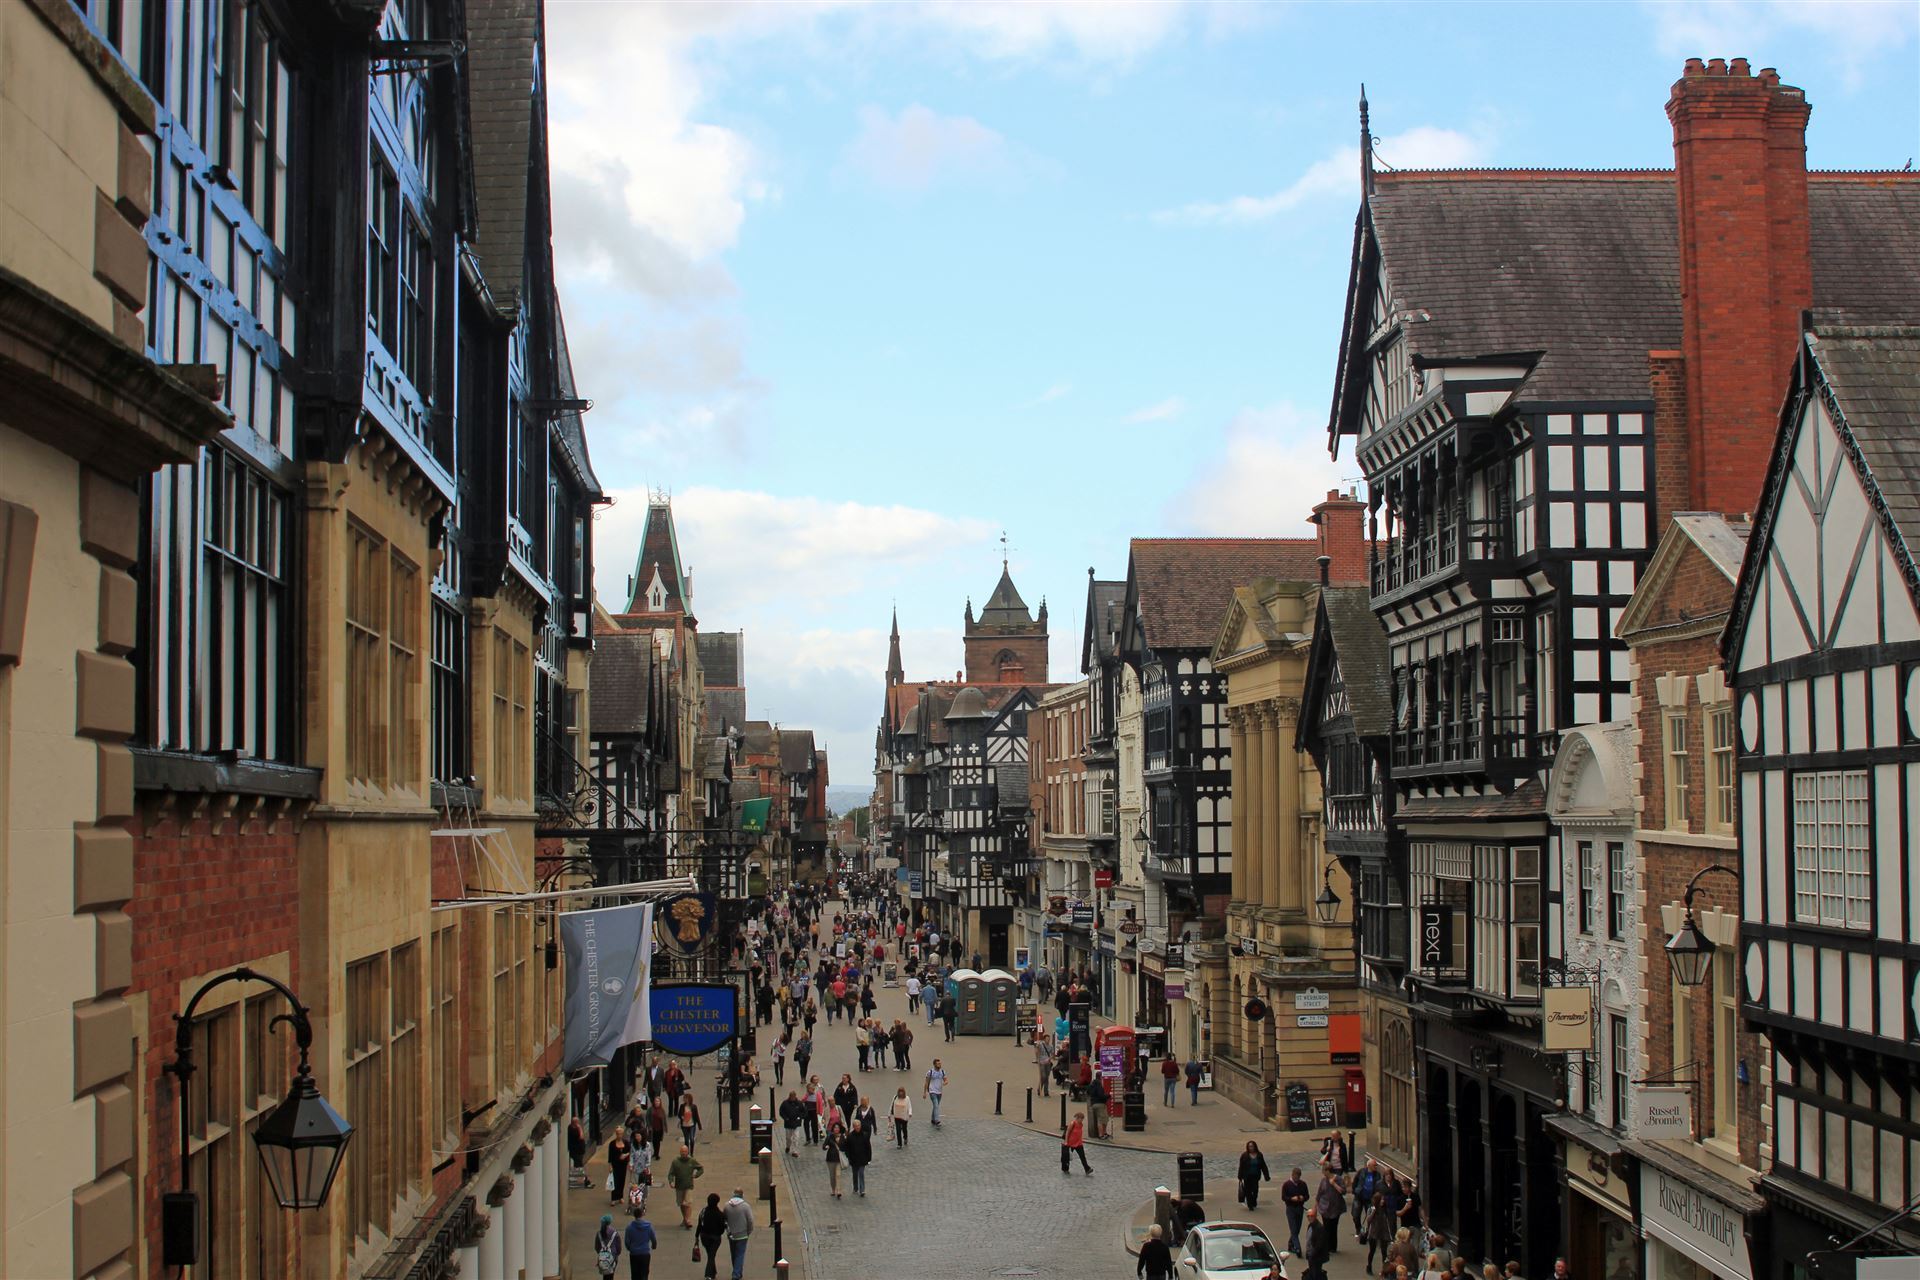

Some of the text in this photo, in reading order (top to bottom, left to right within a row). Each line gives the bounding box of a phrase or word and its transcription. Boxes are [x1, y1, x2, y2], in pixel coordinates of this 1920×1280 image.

[584, 917, 596, 938] THE
[1426, 913, 1440, 961] next
[585, 939, 599, 990] CHESTER
[677, 996, 704, 1006] THE
[660, 1010, 720, 1020] CHESTER
[1547, 1011, 1587, 1024] Thorntons
[652, 1024, 729, 1033] GROSVENOR
[1649, 1105, 1680, 1116] Russell
[1658, 1175, 1691, 1223] Russell
